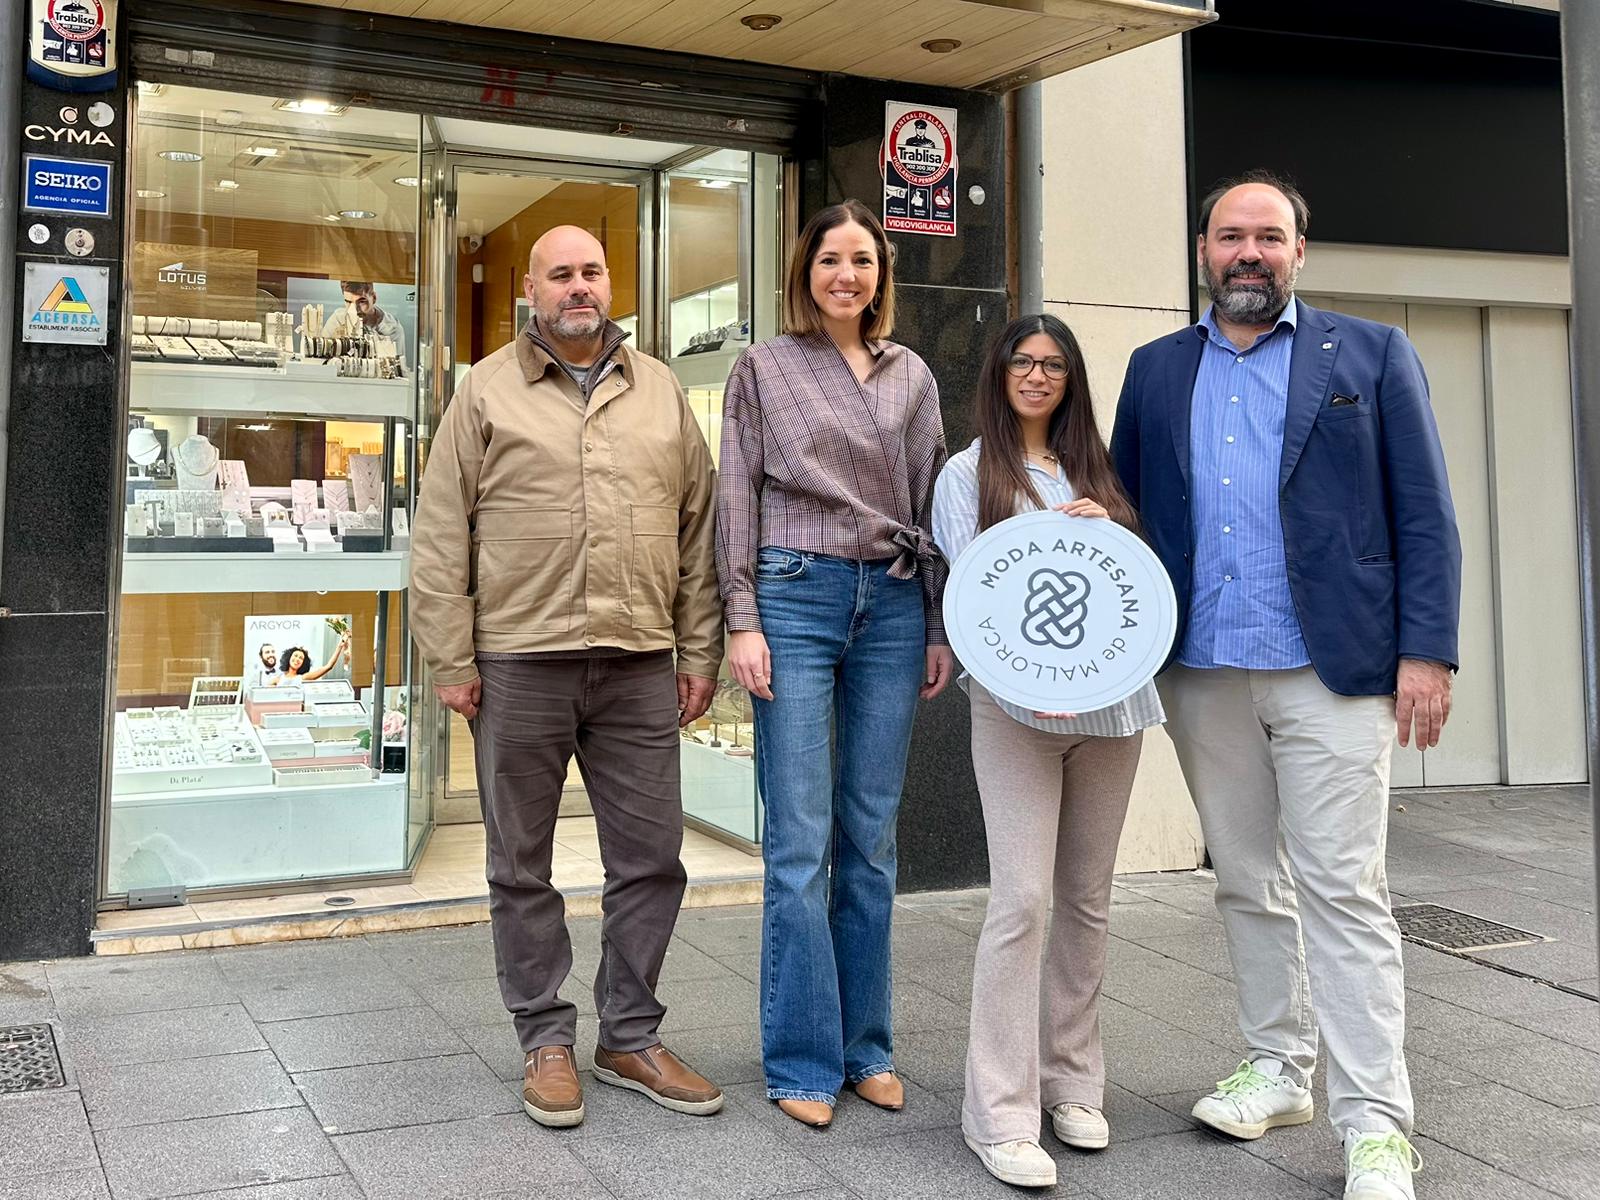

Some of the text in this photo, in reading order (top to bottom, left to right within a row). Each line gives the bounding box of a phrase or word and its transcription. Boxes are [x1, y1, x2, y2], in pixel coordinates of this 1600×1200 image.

[55, 12, 95, 25] Trablisa
[894, 113, 917, 133] CENTRAL
[927, 114, 948, 139] ALARMA
[25, 124, 115, 147] CYMA
[898, 147, 942, 164] Trablisa
[892, 155, 949, 184] VIGILANCIA PERMANENTE
[35, 171, 101, 191] SEIKO
[34, 195, 100, 206] AGENCIA OFICIAL
[888, 219, 952, 232] VIDEOVIGILANCIA
[158, 272, 206, 285] LOTUS
[31, 312, 100, 326] ACEBASA
[29, 324, 69, 332] ESTABLIMENT
[978, 538, 1139, 681] MODA ARTESANA de MALLORCA
[250, 620, 301, 630] ARGYOR
